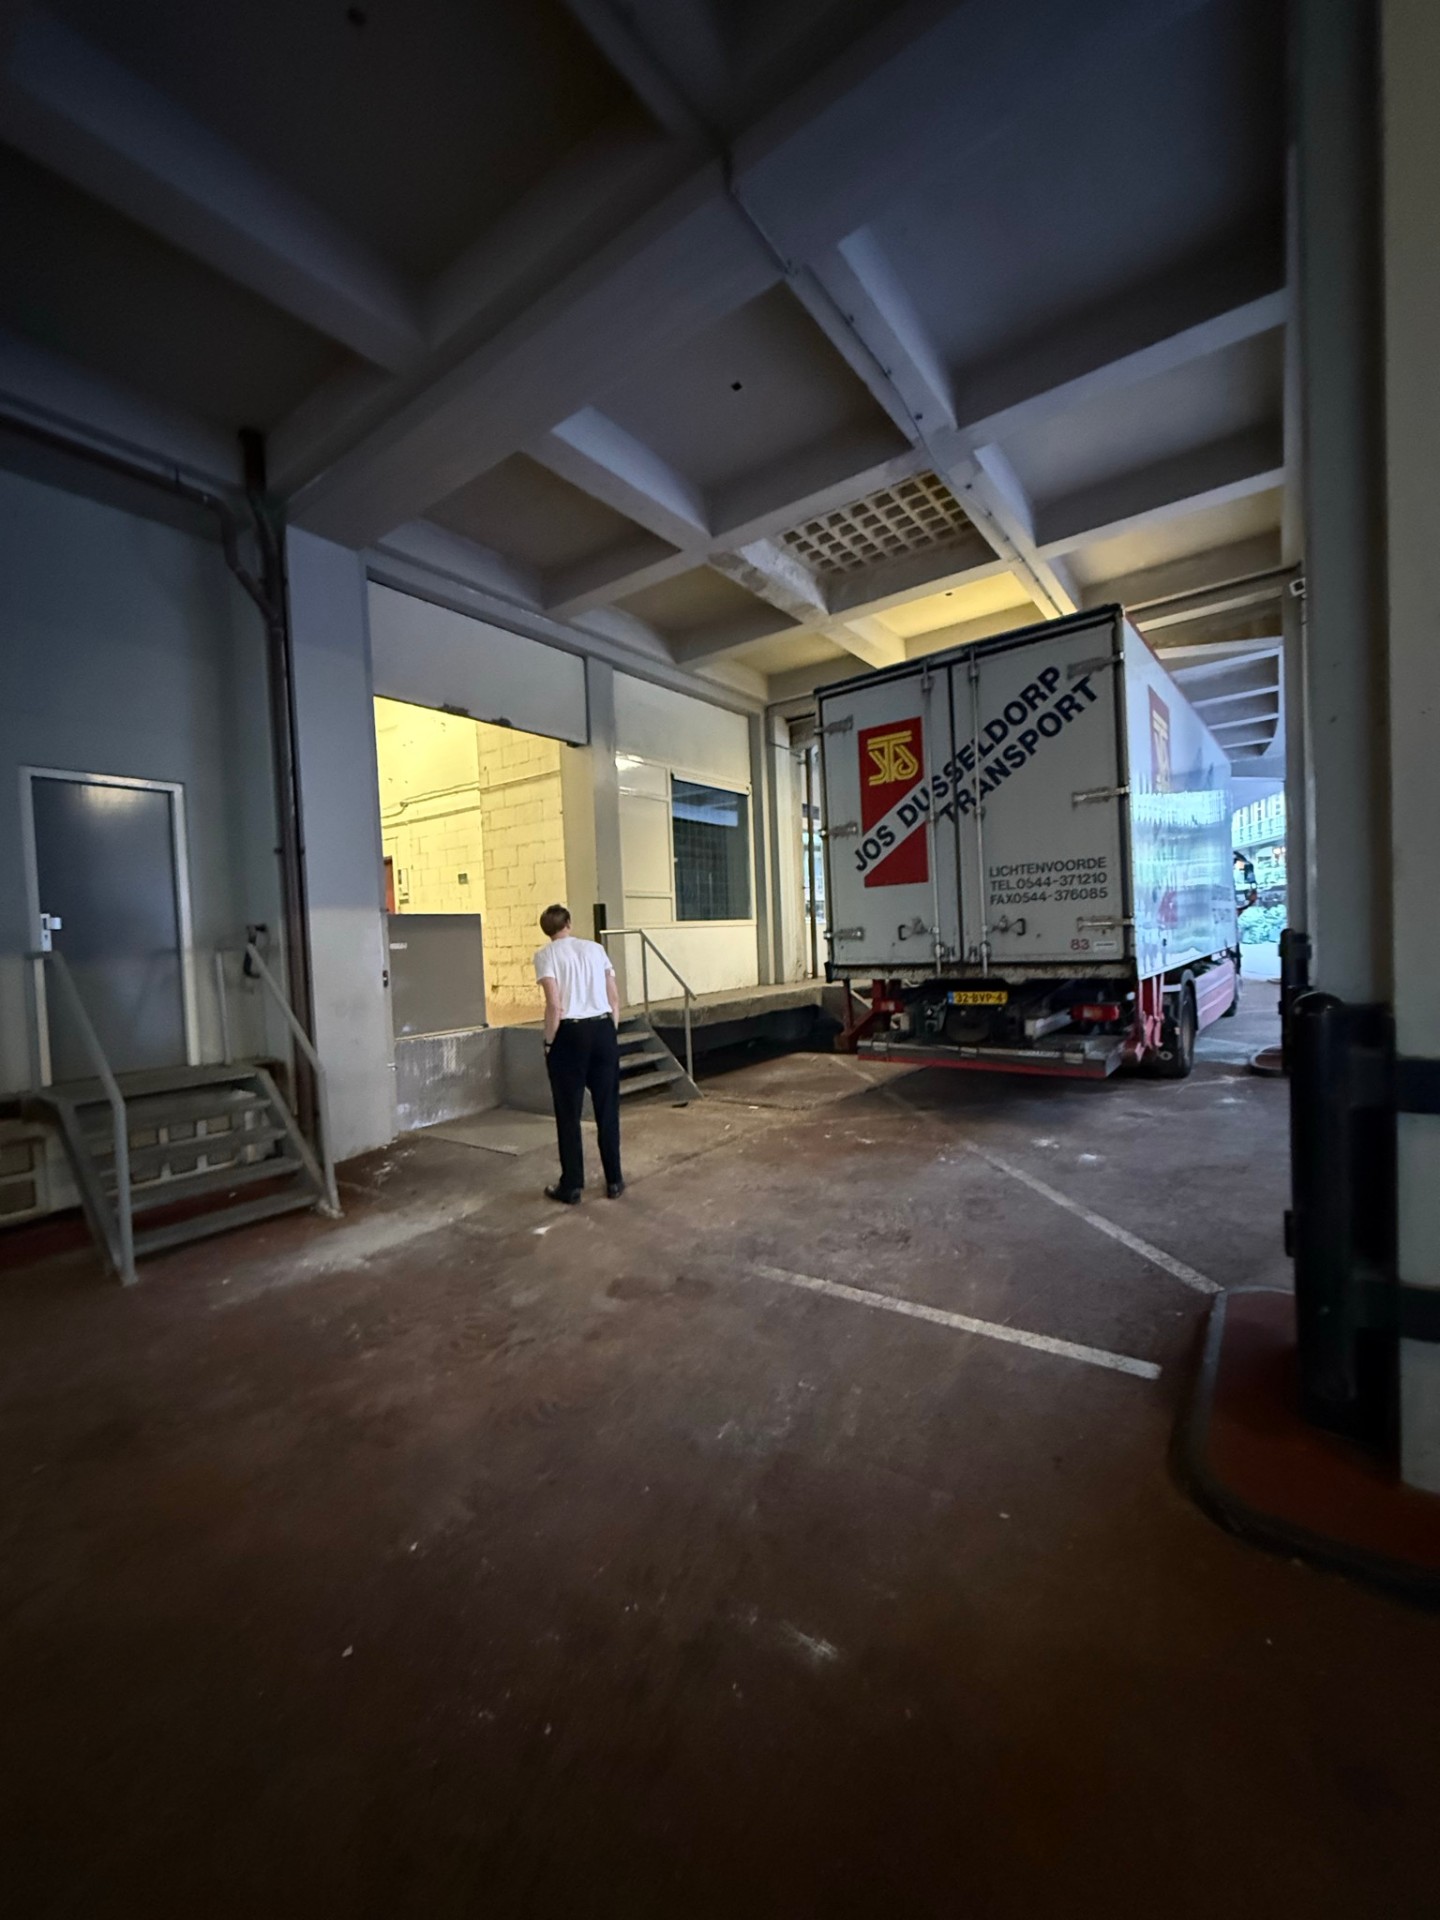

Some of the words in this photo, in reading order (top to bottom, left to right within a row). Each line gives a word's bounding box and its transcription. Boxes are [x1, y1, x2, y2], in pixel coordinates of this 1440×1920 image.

[855, 826, 895, 872] JOS
[896, 666, 1061, 829] DUSSELDORP
[939, 676, 1098, 823] TRANSPORT
[989, 856, 1107, 878] LICHTENVOORDE
[1070, 938, 1090, 951] 83
